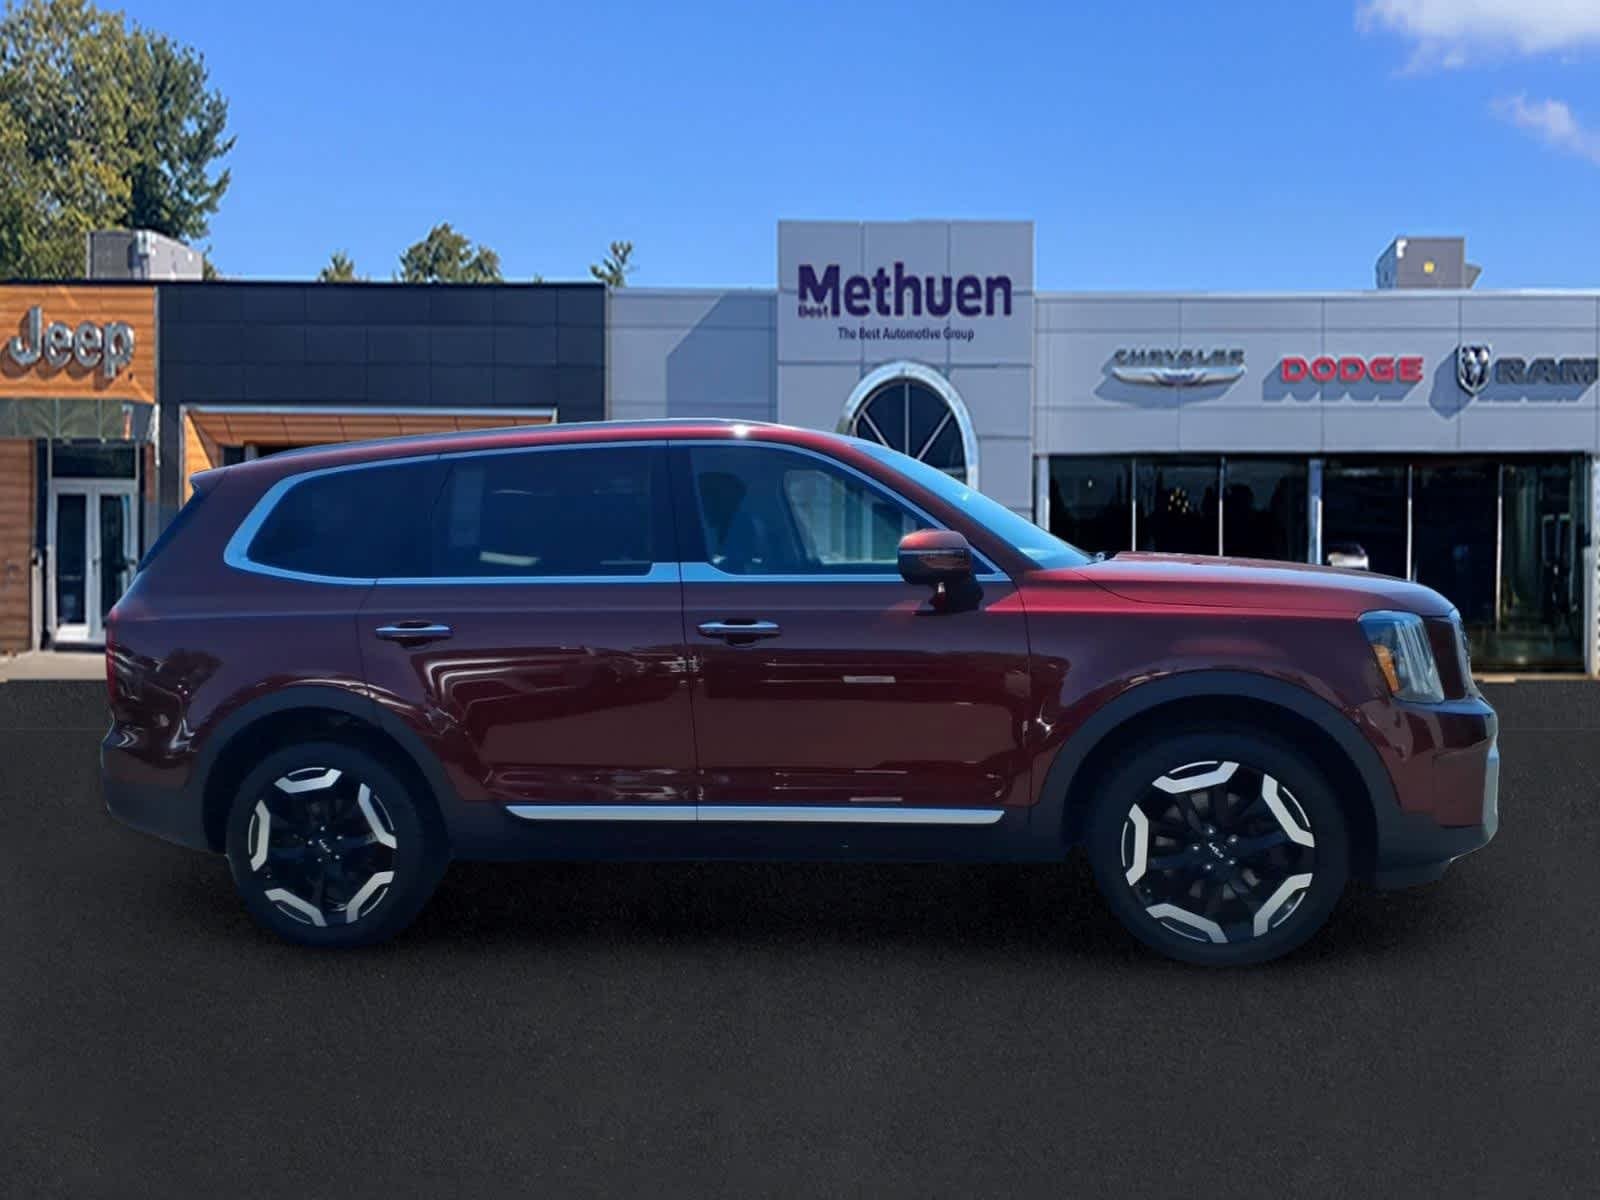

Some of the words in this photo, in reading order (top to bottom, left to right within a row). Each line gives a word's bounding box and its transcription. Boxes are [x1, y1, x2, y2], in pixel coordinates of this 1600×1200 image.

[798, 262, 1012, 317] Methuen
[9, 305, 134, 379] Jeep
[838, 327, 857, 340] The
[859, 327, 881, 340] Best
[882, 327, 941, 340] Automotive
[943, 327, 974, 342] Group
[1113, 349, 1245, 365] CHRYSLER
[1282, 357, 1424, 382] DODGE
[1495, 357, 1599, 384] RAM
